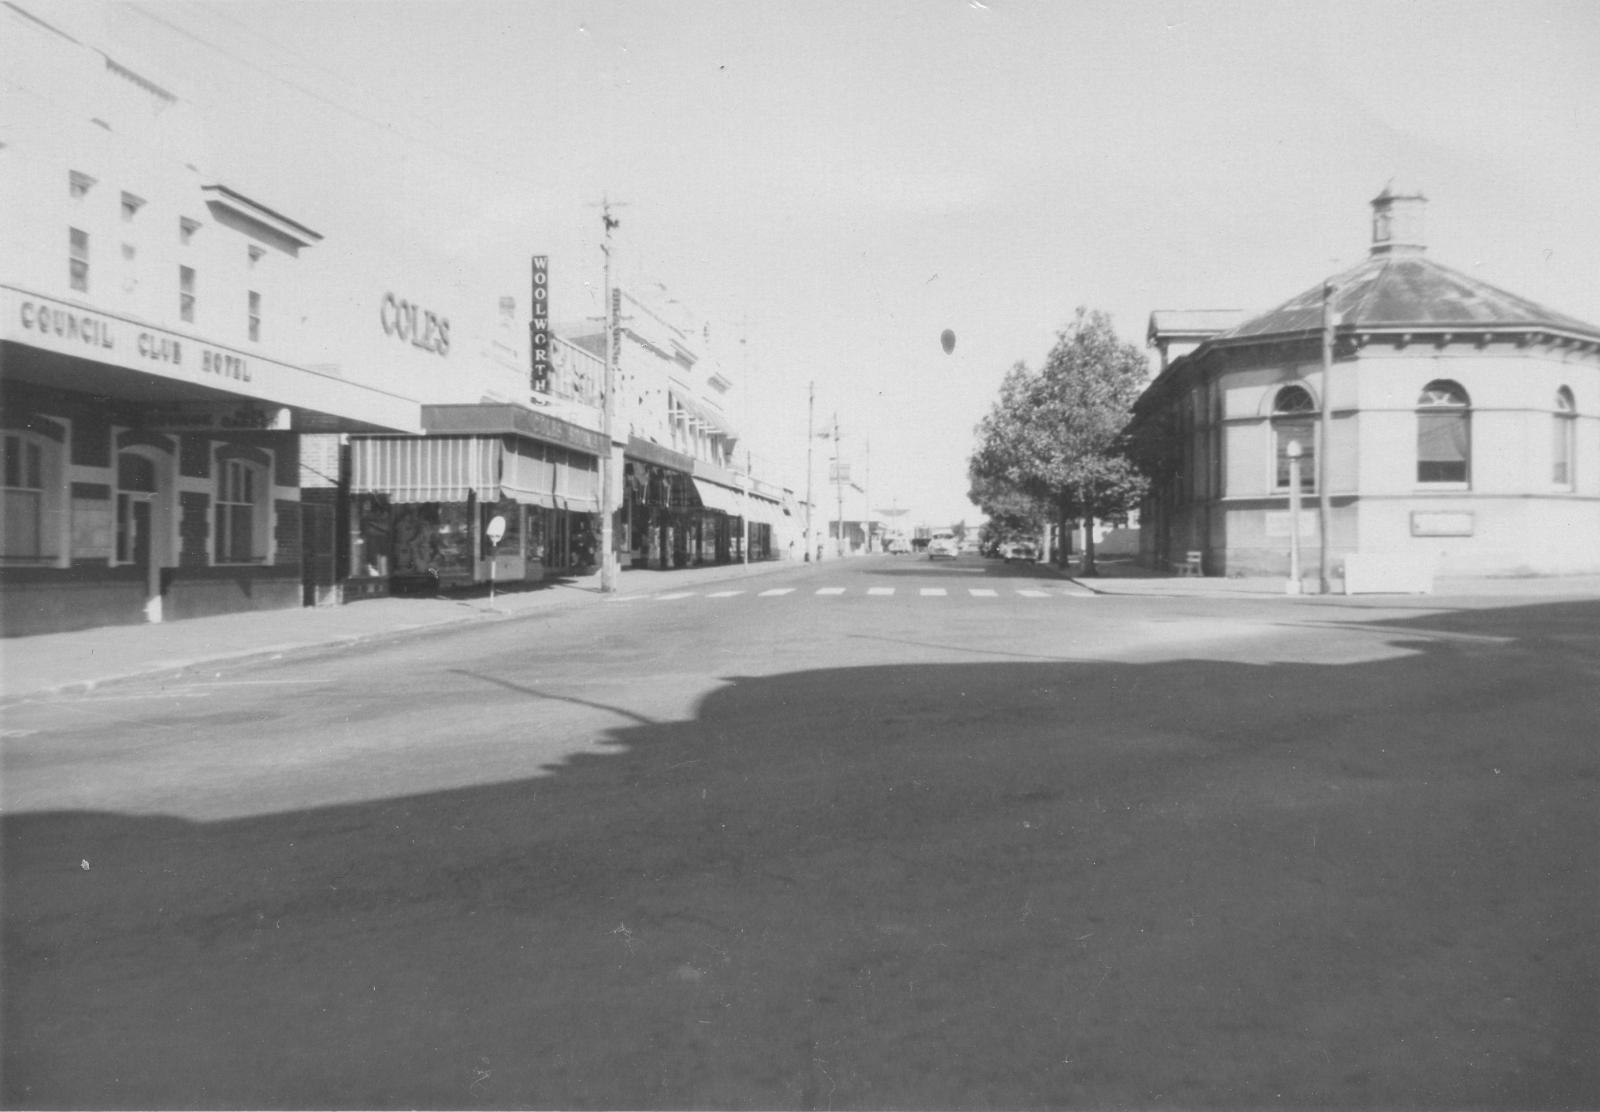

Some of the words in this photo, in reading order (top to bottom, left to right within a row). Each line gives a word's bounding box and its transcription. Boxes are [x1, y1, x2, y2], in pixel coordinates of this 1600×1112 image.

[20, 301, 113, 349] COUNCIL
[203, 350, 251, 383] HOTEL
[381, 291, 449, 357] COLES
